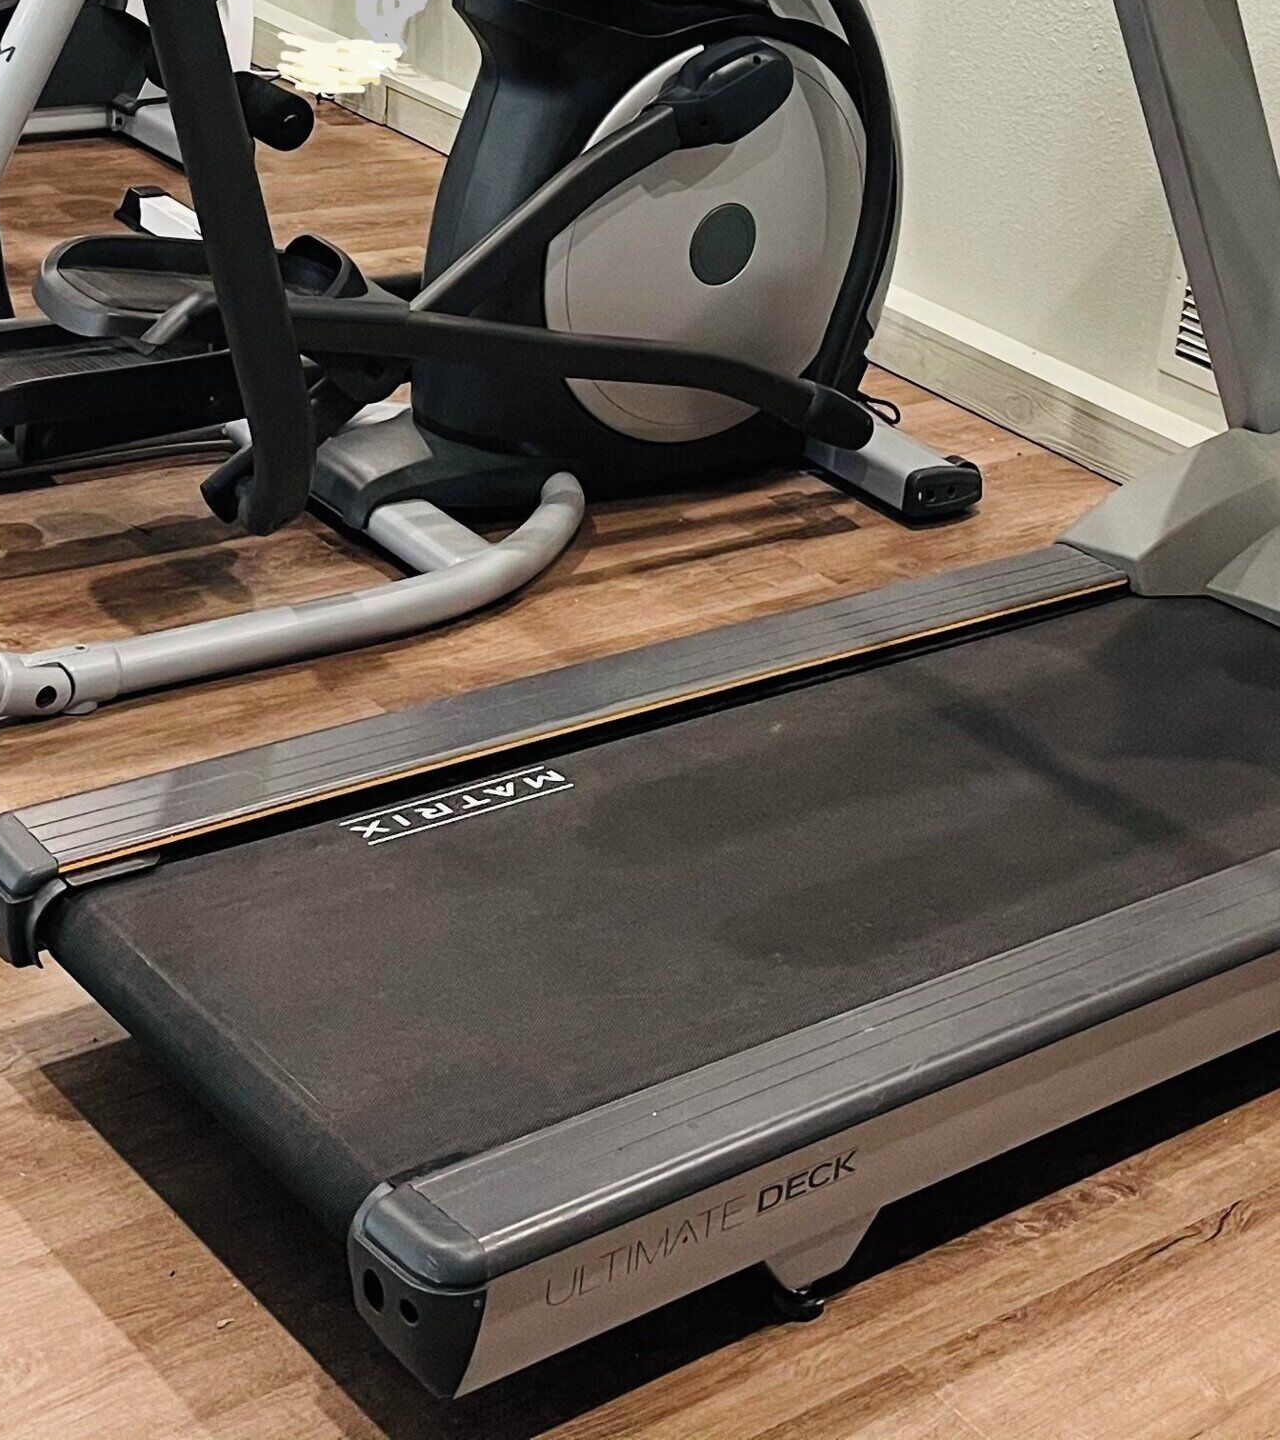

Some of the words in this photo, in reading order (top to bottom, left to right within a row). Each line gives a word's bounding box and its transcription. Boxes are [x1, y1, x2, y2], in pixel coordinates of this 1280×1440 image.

[349, 769, 566, 839] MATRIX
[545, 1194, 746, 1307] ULTIMATE
[757, 1148, 857, 1214] DECK
